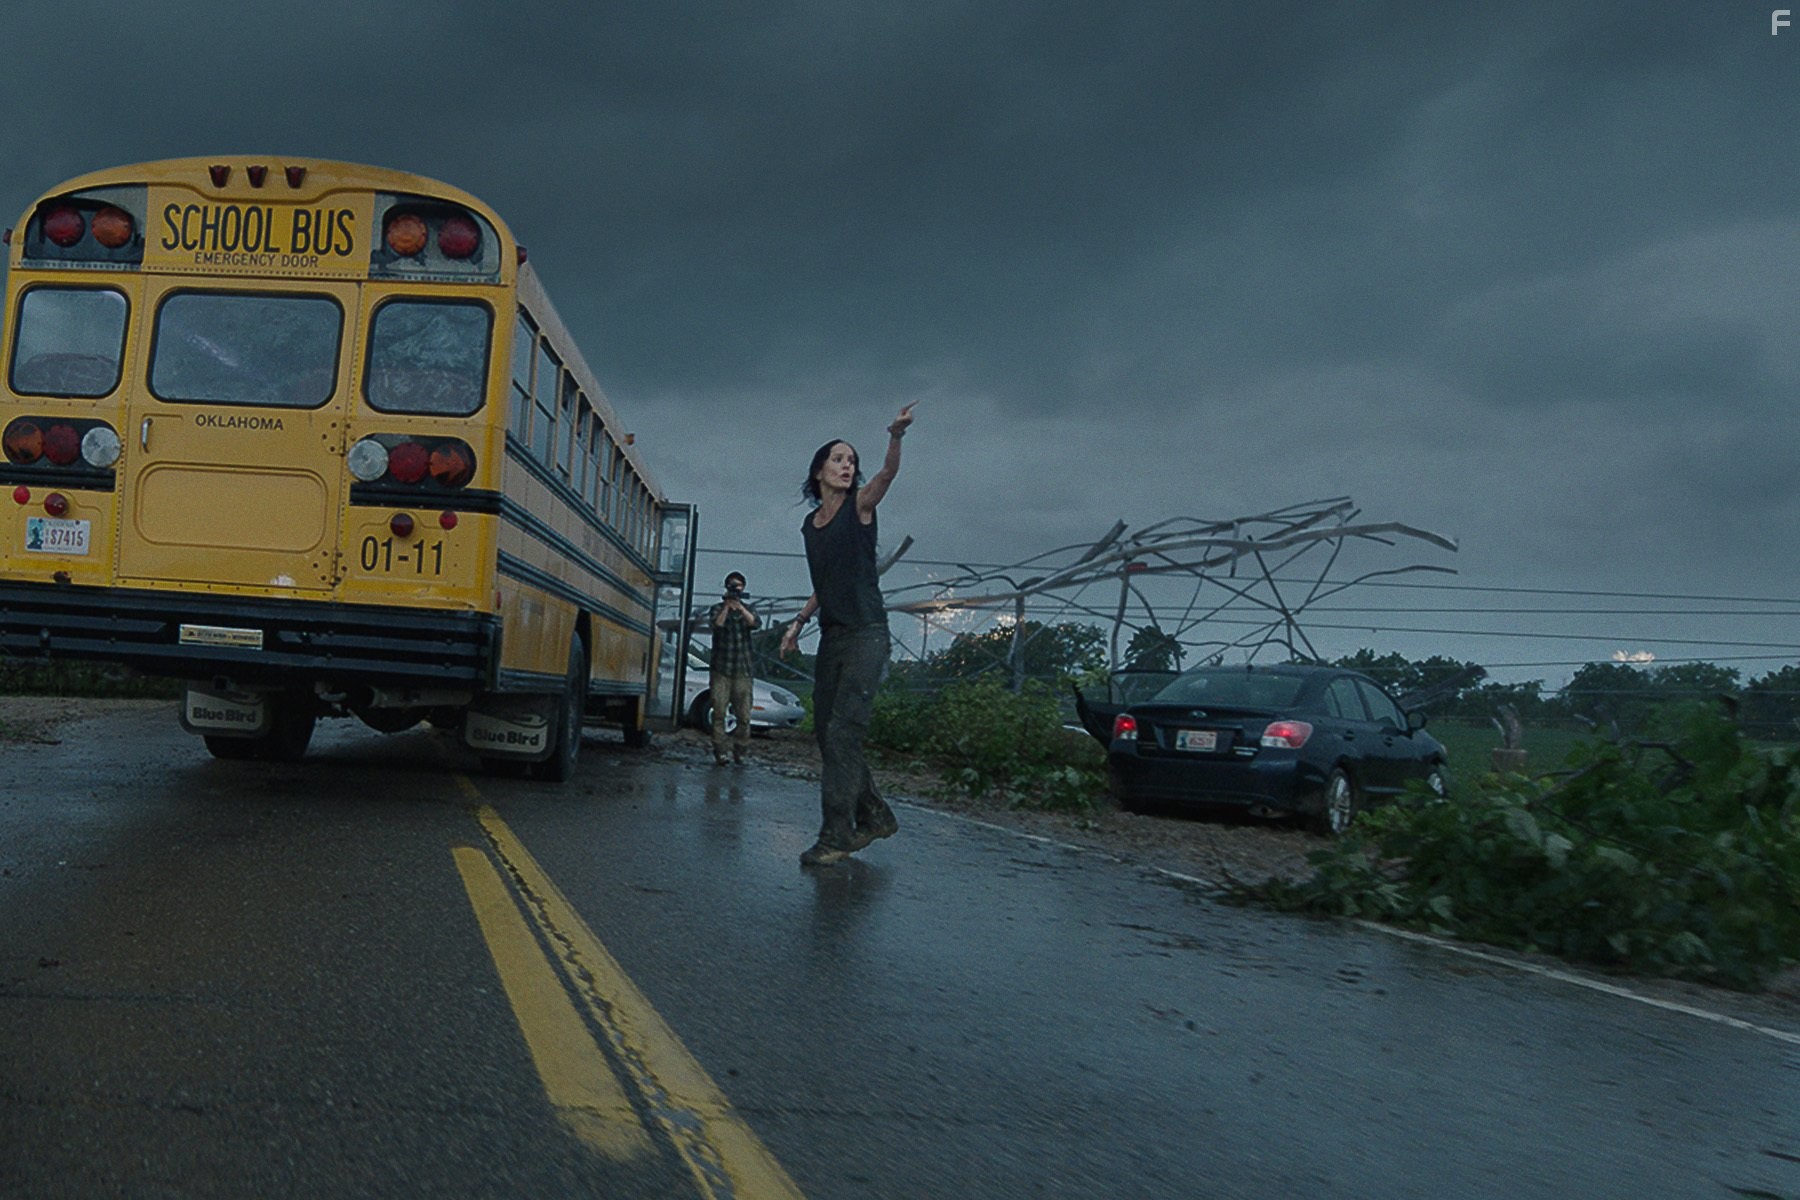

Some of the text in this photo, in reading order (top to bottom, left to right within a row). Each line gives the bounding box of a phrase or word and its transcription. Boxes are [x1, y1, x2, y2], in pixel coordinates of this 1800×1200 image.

[161, 203, 355, 257] SCHOOL BUS
[194, 251, 319, 268] EMERGENCY DOOR
[195, 413, 284, 431] OKLAHOMA
[361, 535, 443, 575] 01-11
